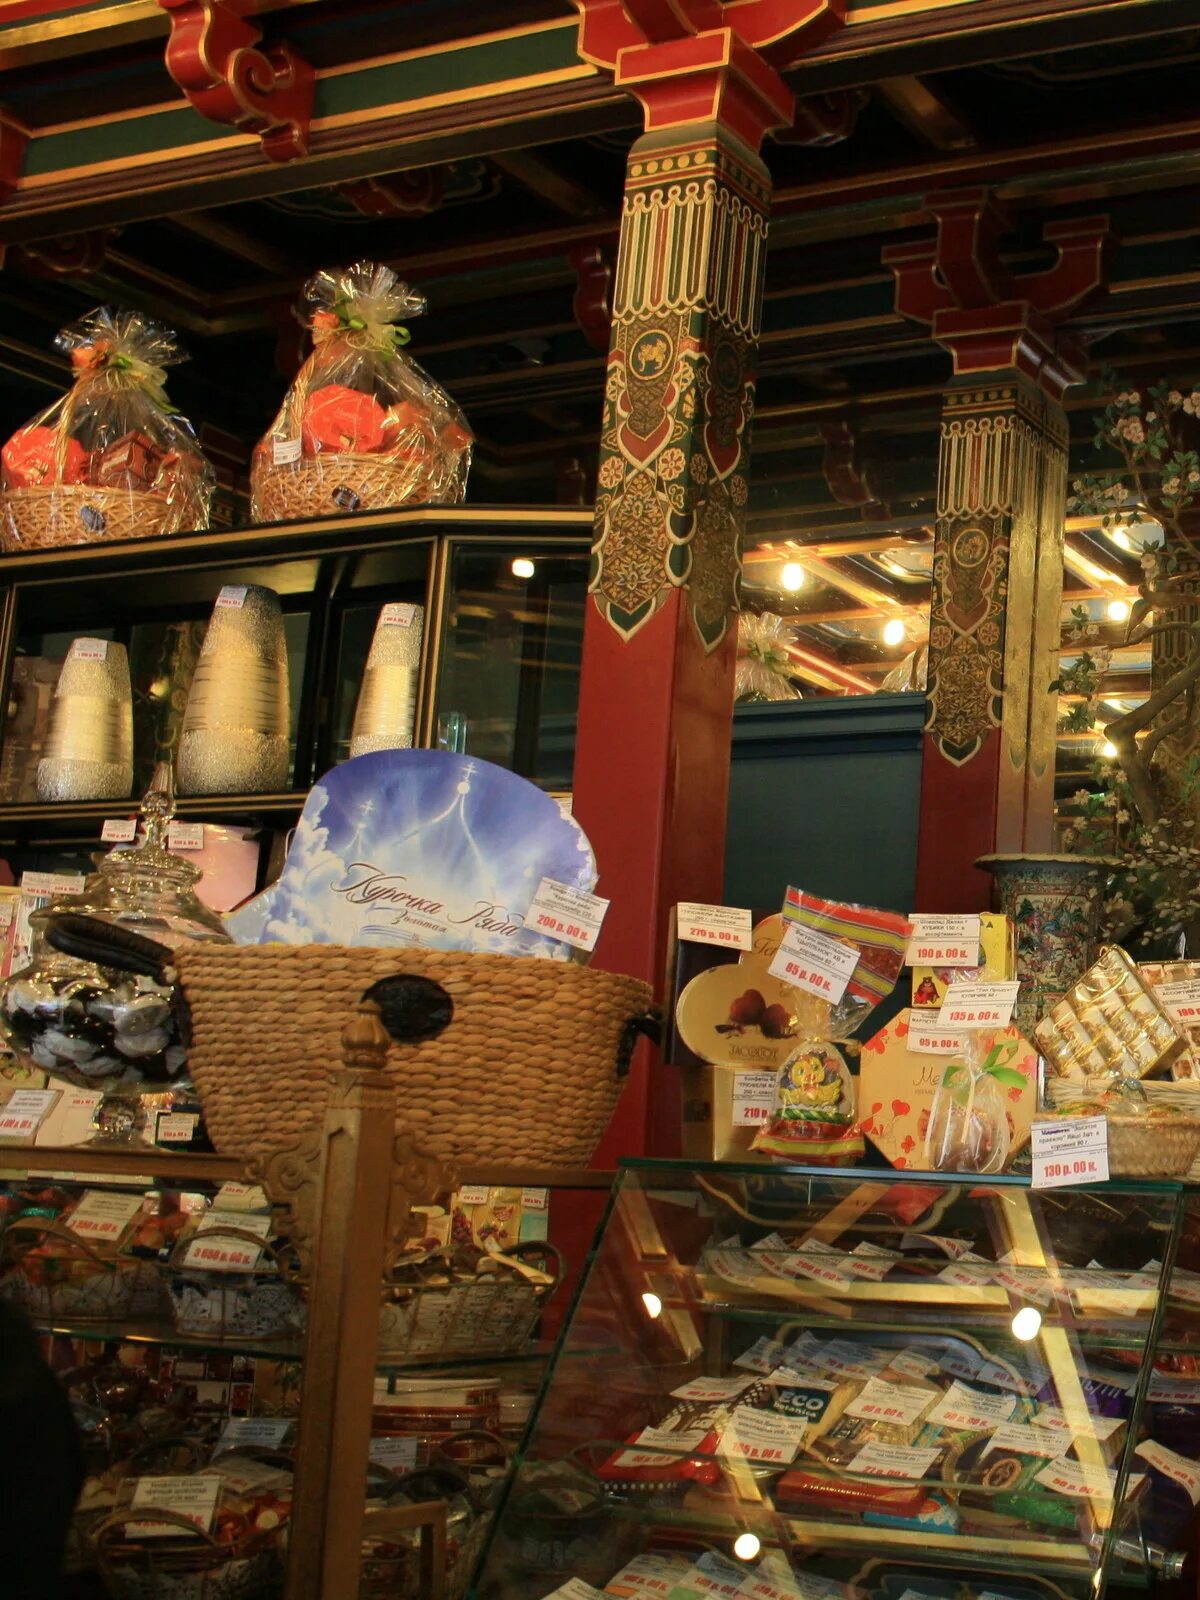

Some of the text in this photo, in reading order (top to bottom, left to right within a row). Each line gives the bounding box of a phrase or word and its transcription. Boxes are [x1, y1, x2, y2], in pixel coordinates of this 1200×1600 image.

[330, 863, 444, 915] Курочка
[447, 900, 526, 936] Ряба
[537, 914, 556, 928] 200
[566, 925, 580, 937] 00
[719, 931, 731, 941] 00
[917, 948, 934, 959] 190
[945, 948, 959, 959] 00
[785, 962, 799, 976] 85
[809, 972, 823, 987] 00
[949, 1011, 966, 1021] 135
[977, 1011, 991, 1020] 00
[1177, 1007, 1195, 1017] 190
[919, 1038, 931, 1047] 95
[940, 1039, 951, 1048] 00
[743, 1107, 760, 1118] 210
[1044, 1163, 1061, 1177] 130
[1062, 1165, 1071, 1176] р.
[1073, 1160, 1086, 1174] 00
[779, 1390, 825, 1411] ECO
